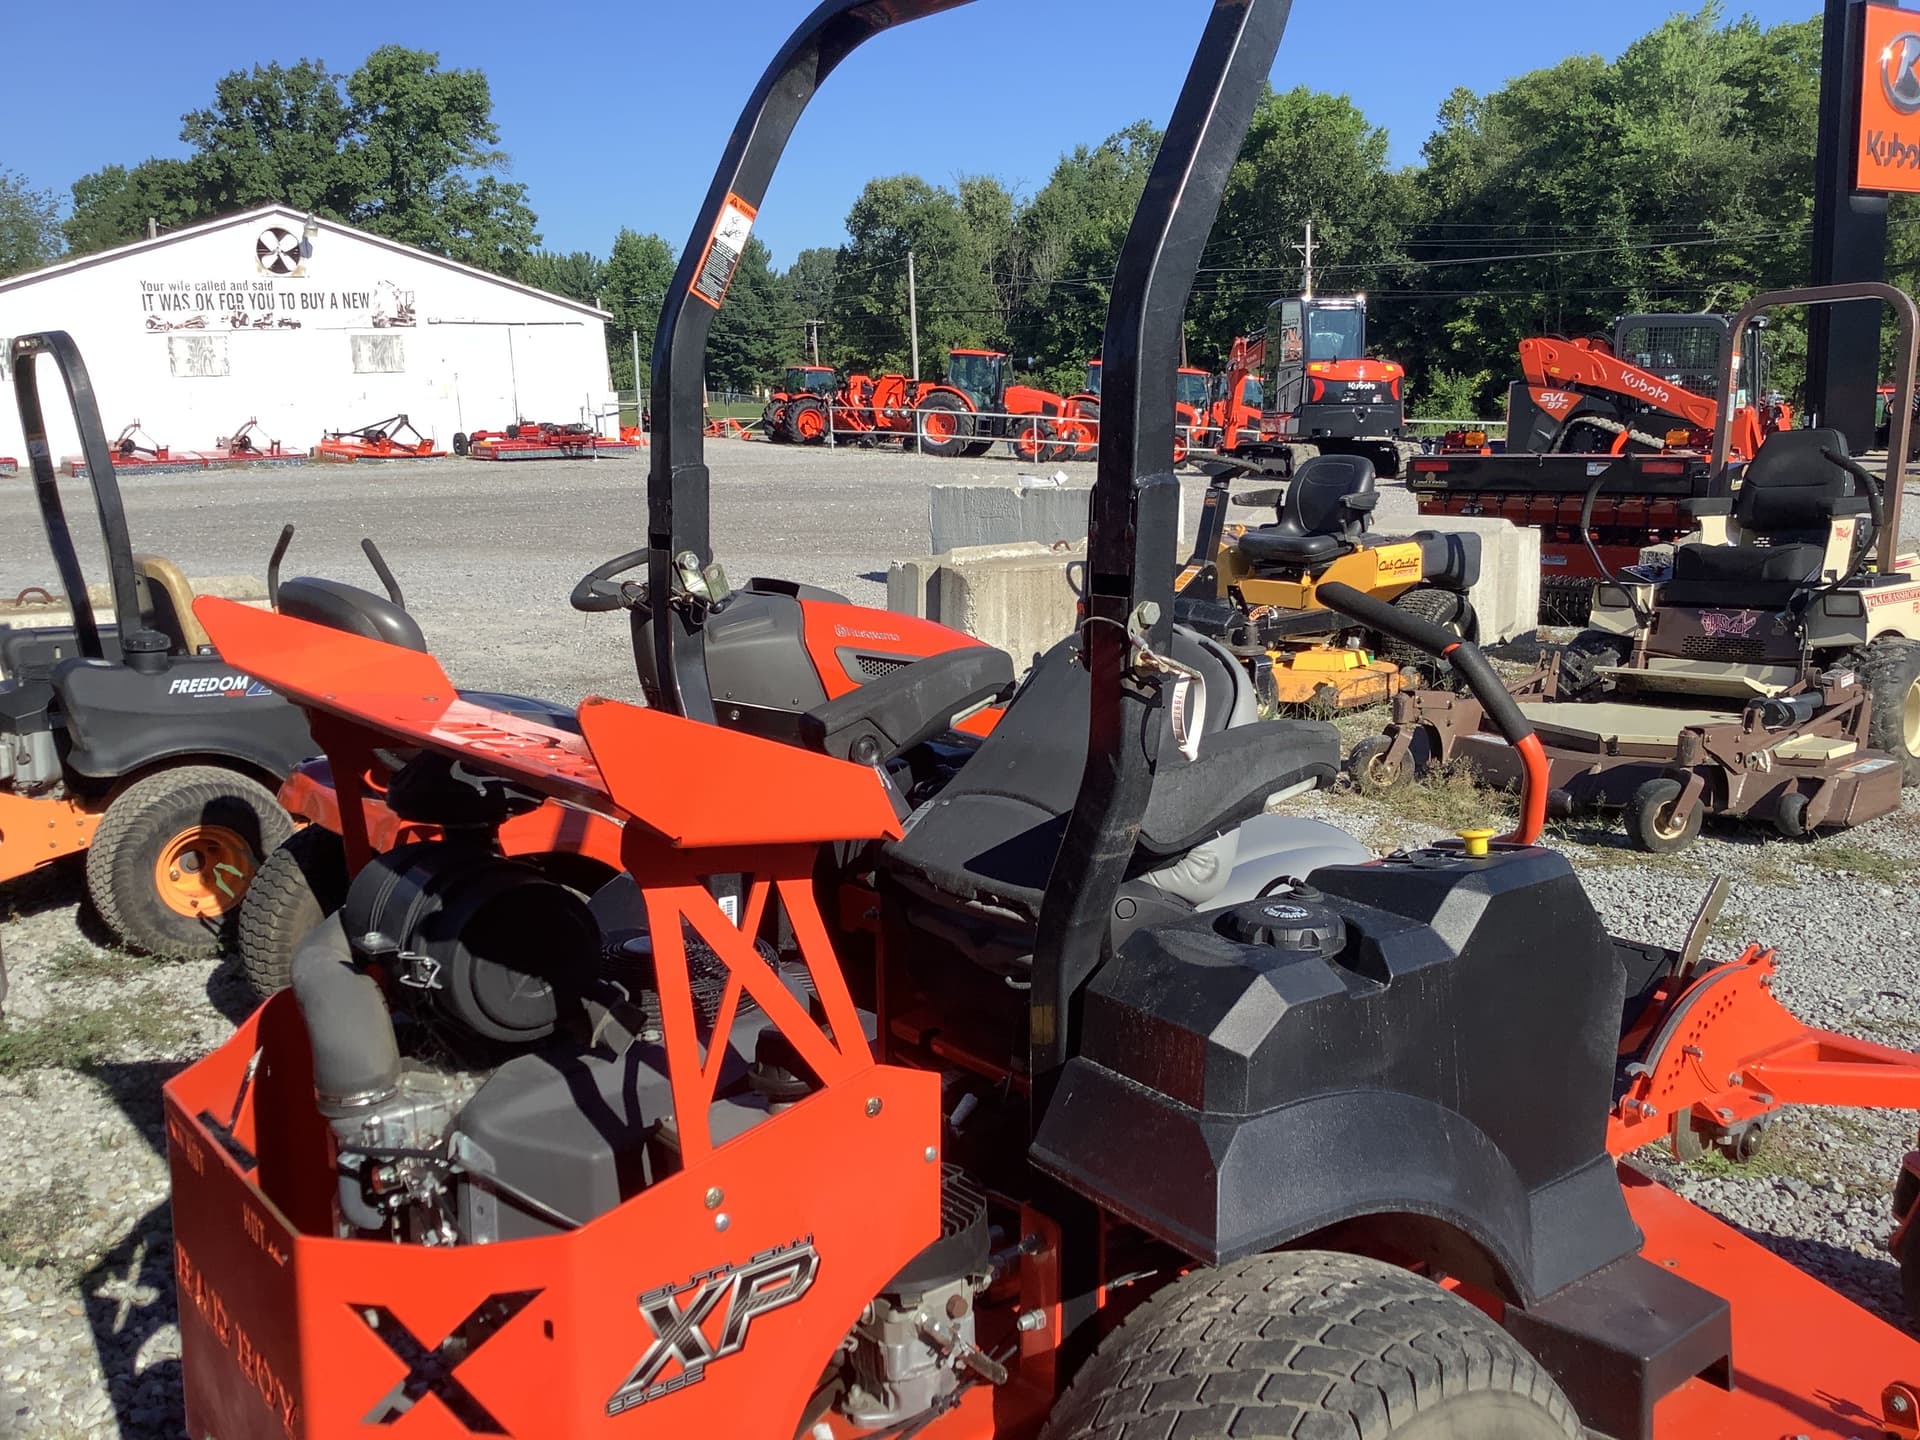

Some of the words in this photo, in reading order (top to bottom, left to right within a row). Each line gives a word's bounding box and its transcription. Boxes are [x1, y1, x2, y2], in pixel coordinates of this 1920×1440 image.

[1866, 129, 1920, 169] Kubo
[139, 280, 164, 292] Your
[169, 280, 191, 291] wife
[195, 280, 226, 291] called
[230, 280, 249, 291] and
[252, 280, 274, 291] said
[141, 293, 154, 311] IT
[159, 293, 190, 311] WAS
[195, 293, 215, 311] OK
[219, 292, 245, 310] FOR
[249, 293, 275, 310] YOU
[279, 293, 296, 310] TO
[301, 292, 326, 309] BUY
[330, 292, 338, 309] A
[342, 292, 370, 309] NEW
[1348, 381, 1376, 390] Kubota
[1620, 370, 1669, 403] Kubota
[1539, 393, 1569, 402] SVL
[1379, 560, 1393, 571] Cub
[1394, 558, 1419, 569] Cadet
[168, 676, 249, 694] FREEDOM
[615, 1245, 821, 1397] XP
[175, 1239, 232, 1349] BAD
[235, 1321, 298, 1440] BOY
